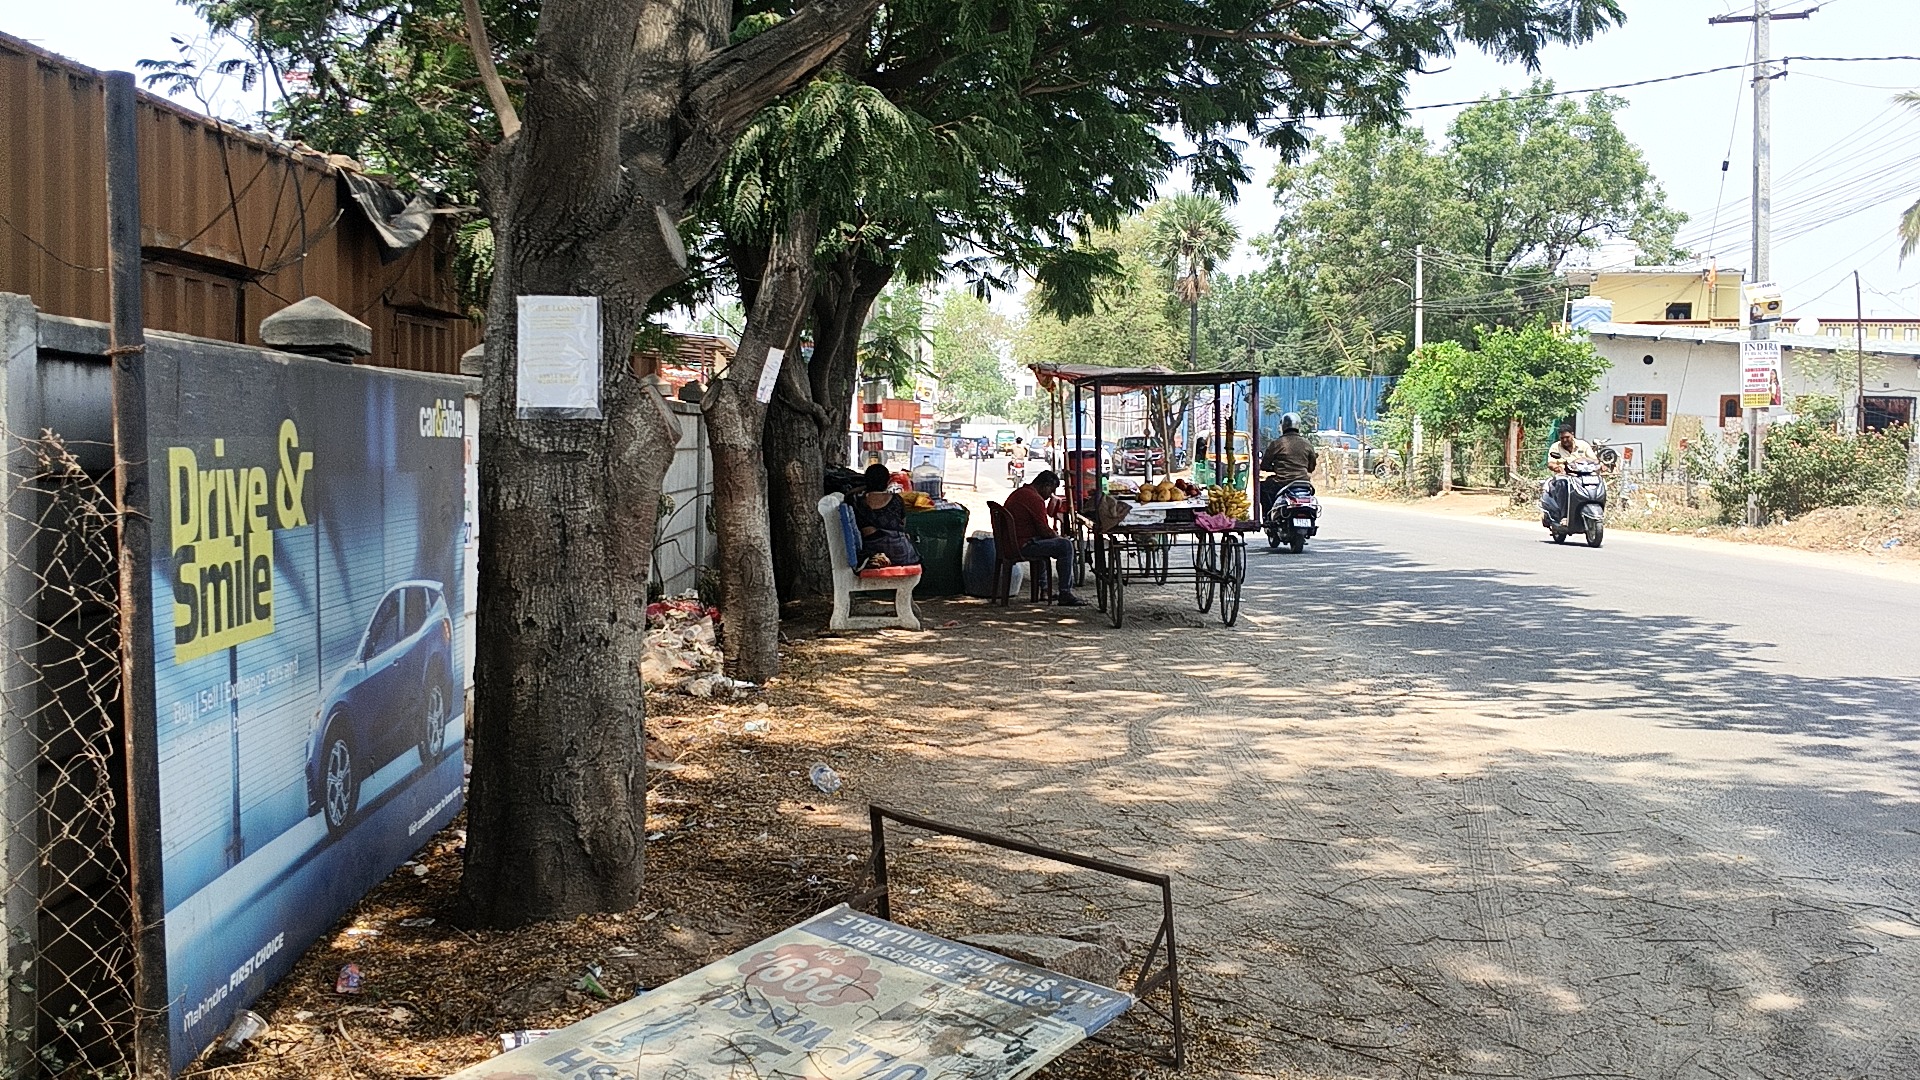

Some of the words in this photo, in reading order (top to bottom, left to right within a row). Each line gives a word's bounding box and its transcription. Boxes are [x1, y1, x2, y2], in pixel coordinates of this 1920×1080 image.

[1745, 343, 1778, 351] INDIRA
[419, 399, 462, 438] car&bike
[168, 438, 268, 546] Drive
[276, 419, 313, 529] &
[173, 532, 272, 645] Smile
[173, 701, 194, 725] Buy
[201, 684, 219, 712] Sell
[225, 673, 265, 702] Exchange
[833, 914, 949, 959] AVAILABLE
[837, 933, 949, 974] 9390931801
[816, 950, 846, 966] Only
[951, 951, 1058, 992] SERVICE
[184, 984, 228, 1033] Mahindra
[229, 956, 255, 991] FIRST
[255, 932, 284, 969] CHOICE
[1061, 984, 1112, 1008] ALL
